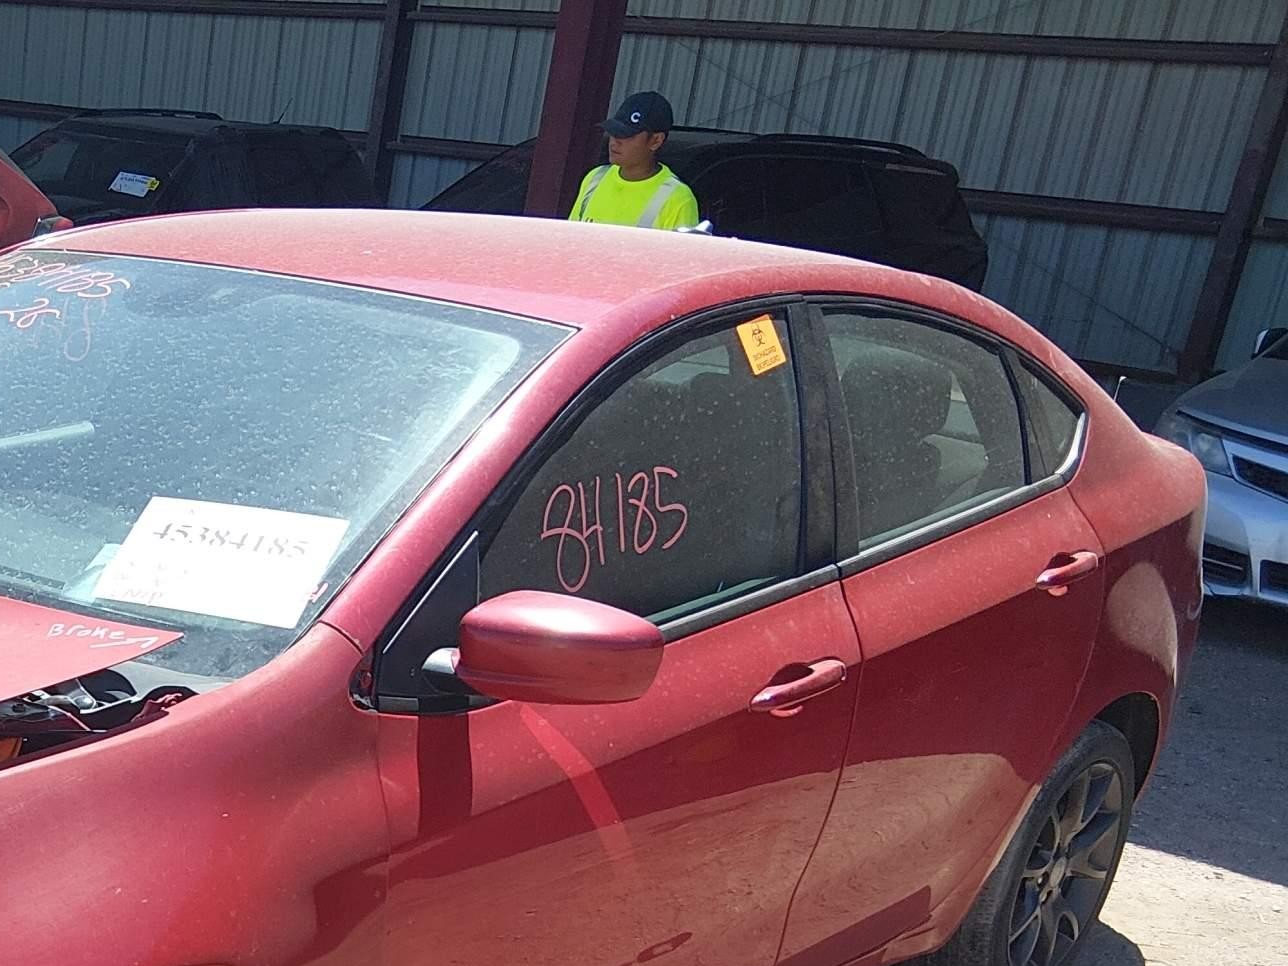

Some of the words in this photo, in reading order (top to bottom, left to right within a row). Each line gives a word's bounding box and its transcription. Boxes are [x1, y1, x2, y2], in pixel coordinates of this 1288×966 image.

[630, 112, 641, 123] C
[153, 523, 308, 557] 45384185
[541, 466, 688, 593] 84185
